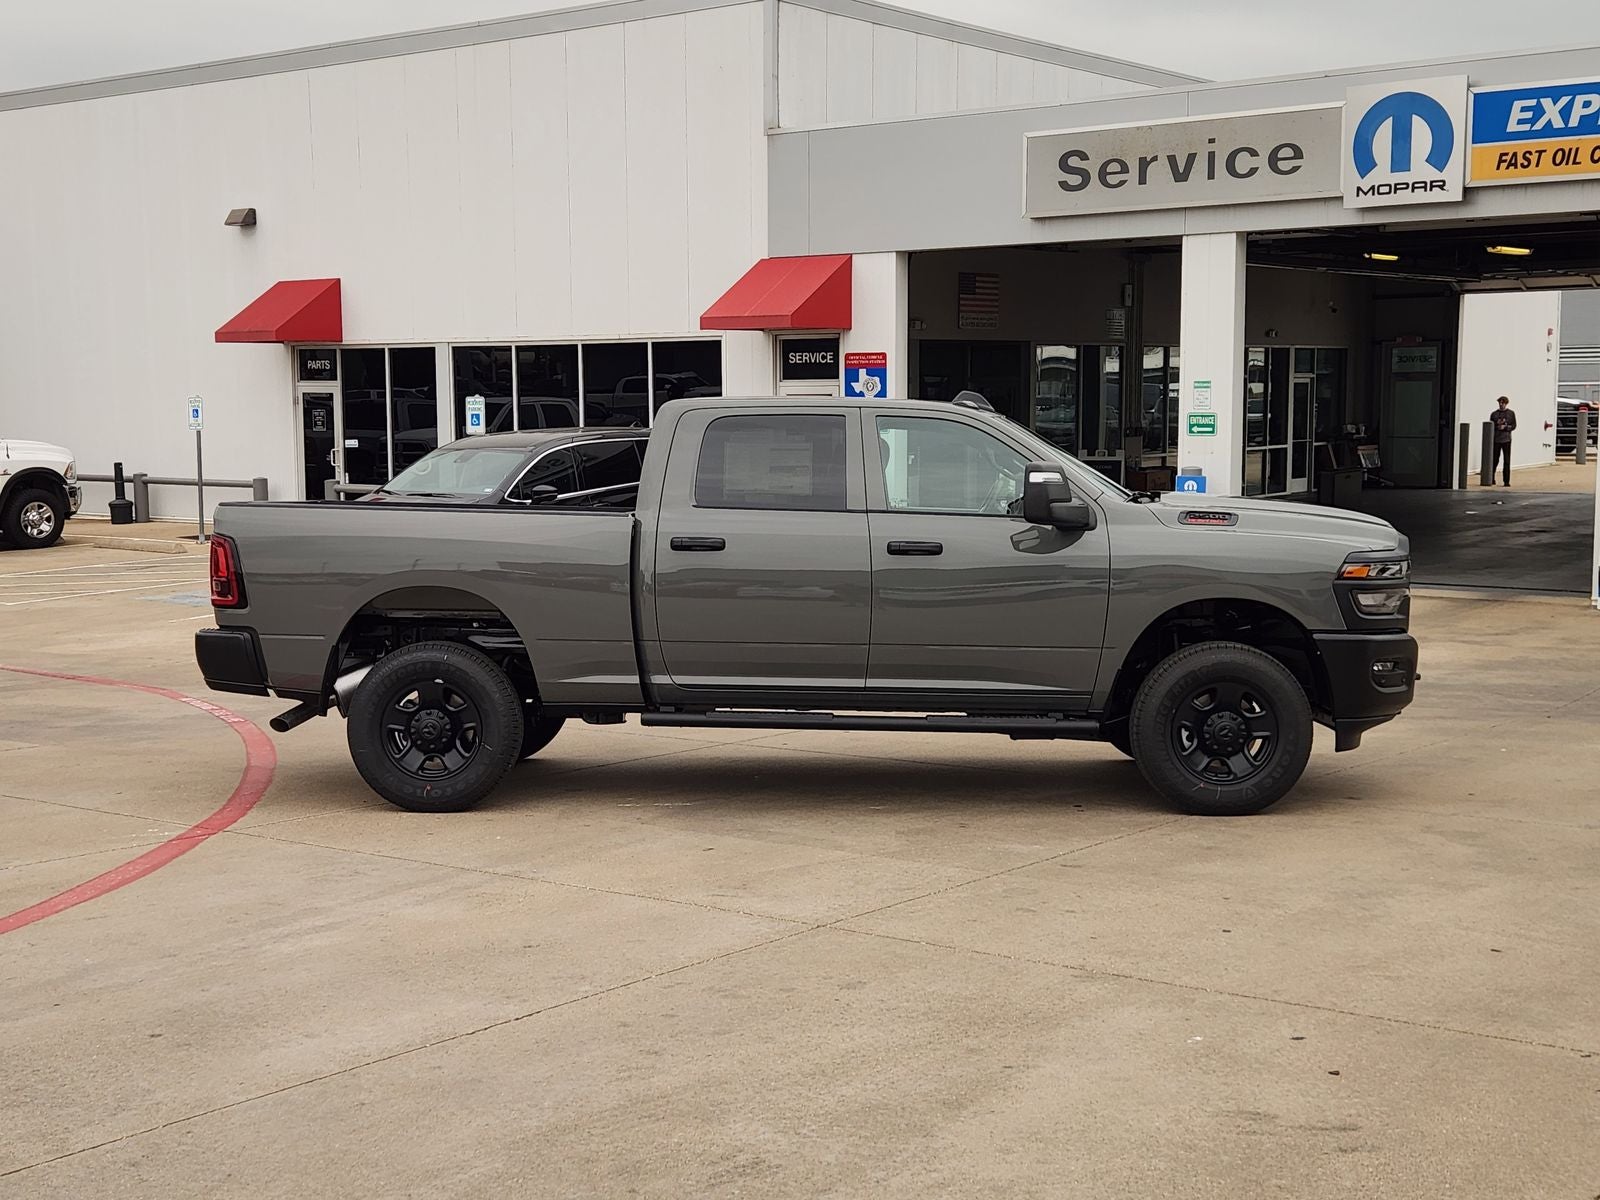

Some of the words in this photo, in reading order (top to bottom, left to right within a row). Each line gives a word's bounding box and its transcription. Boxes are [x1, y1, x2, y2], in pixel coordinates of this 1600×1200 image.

[1506, 93, 1600, 133] EXP
[1058, 137, 1304, 192] Service
[1496, 149, 1547, 171] FAST
[1552, 147, 1582, 167] OIL
[1356, 179, 1447, 198] MOPAR
[307, 360, 331, 370] PARTS
[788, 352, 834, 364] SERVICE
[1190, 416, 1215, 425] ENTRANCE
